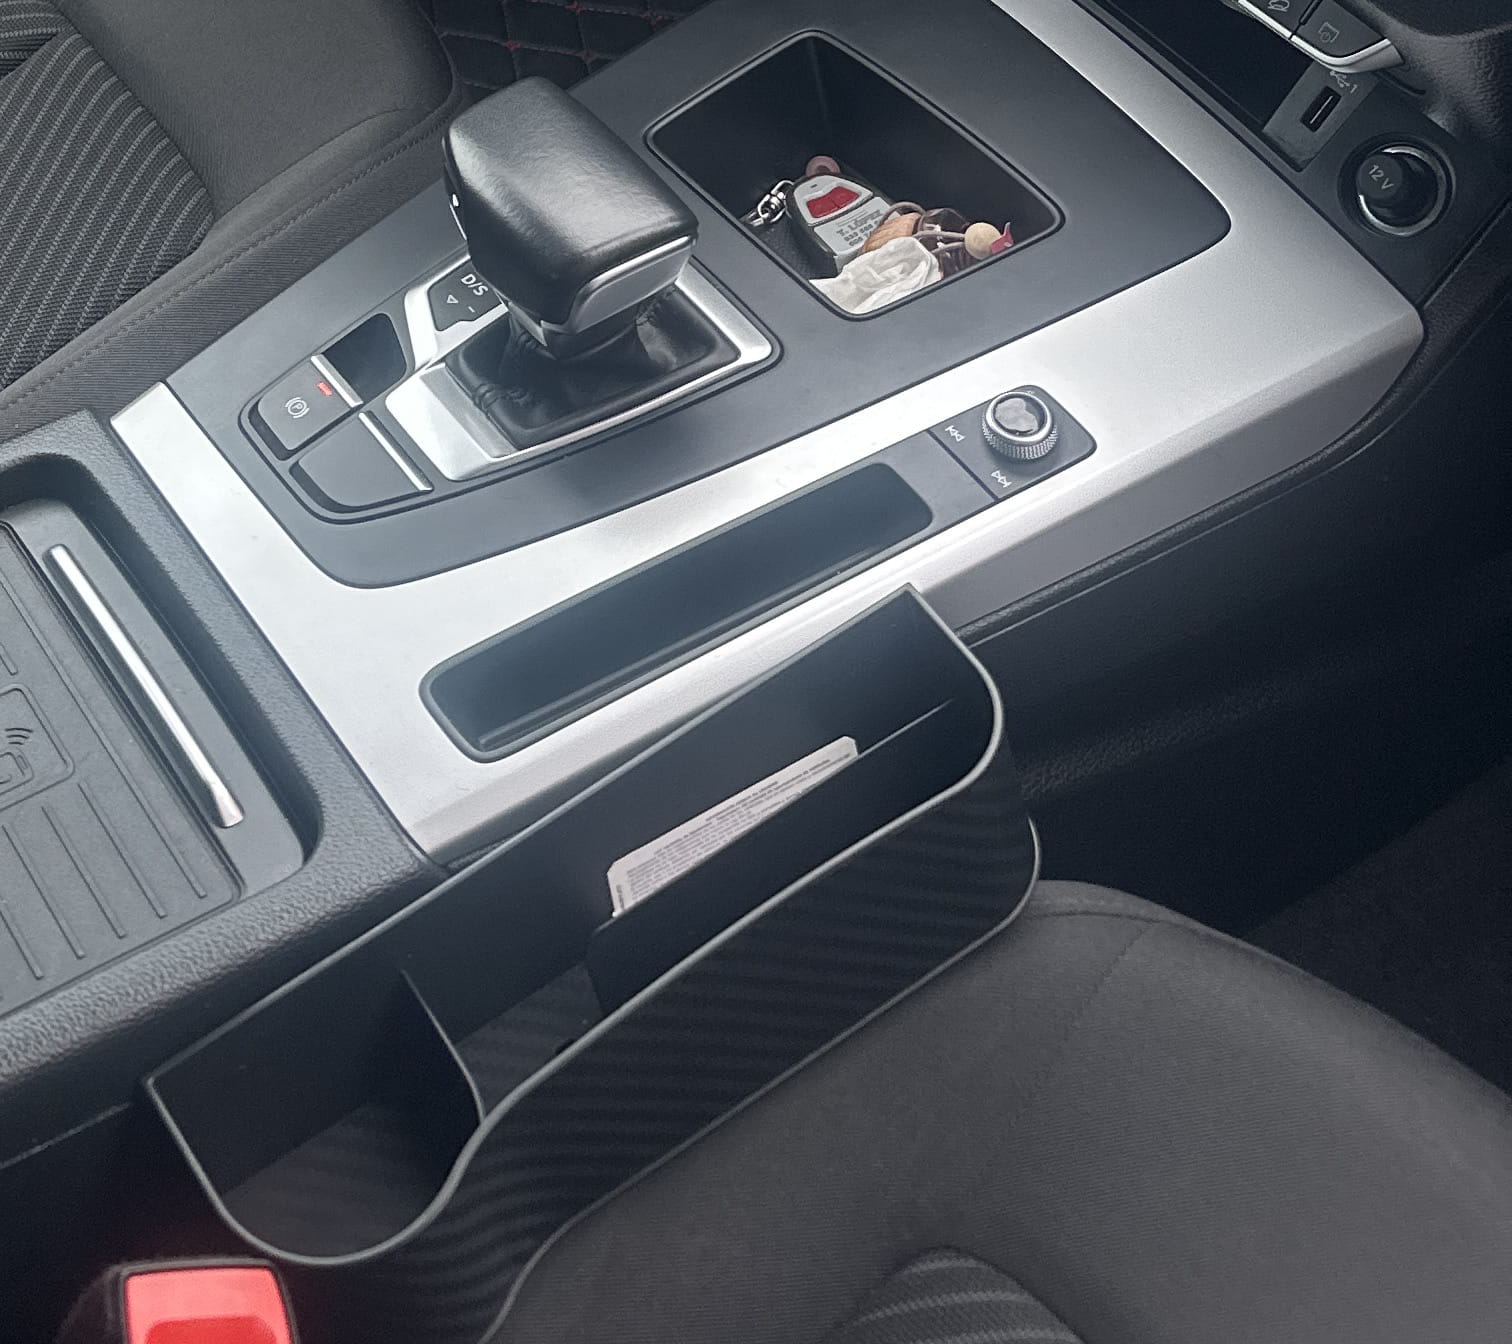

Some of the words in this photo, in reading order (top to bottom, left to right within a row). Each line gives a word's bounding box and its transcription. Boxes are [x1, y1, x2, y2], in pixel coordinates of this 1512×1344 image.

[1368, 164, 1384, 182] 12
[1381, 177, 1395, 190] V
[461, 273, 489, 296] D/S
